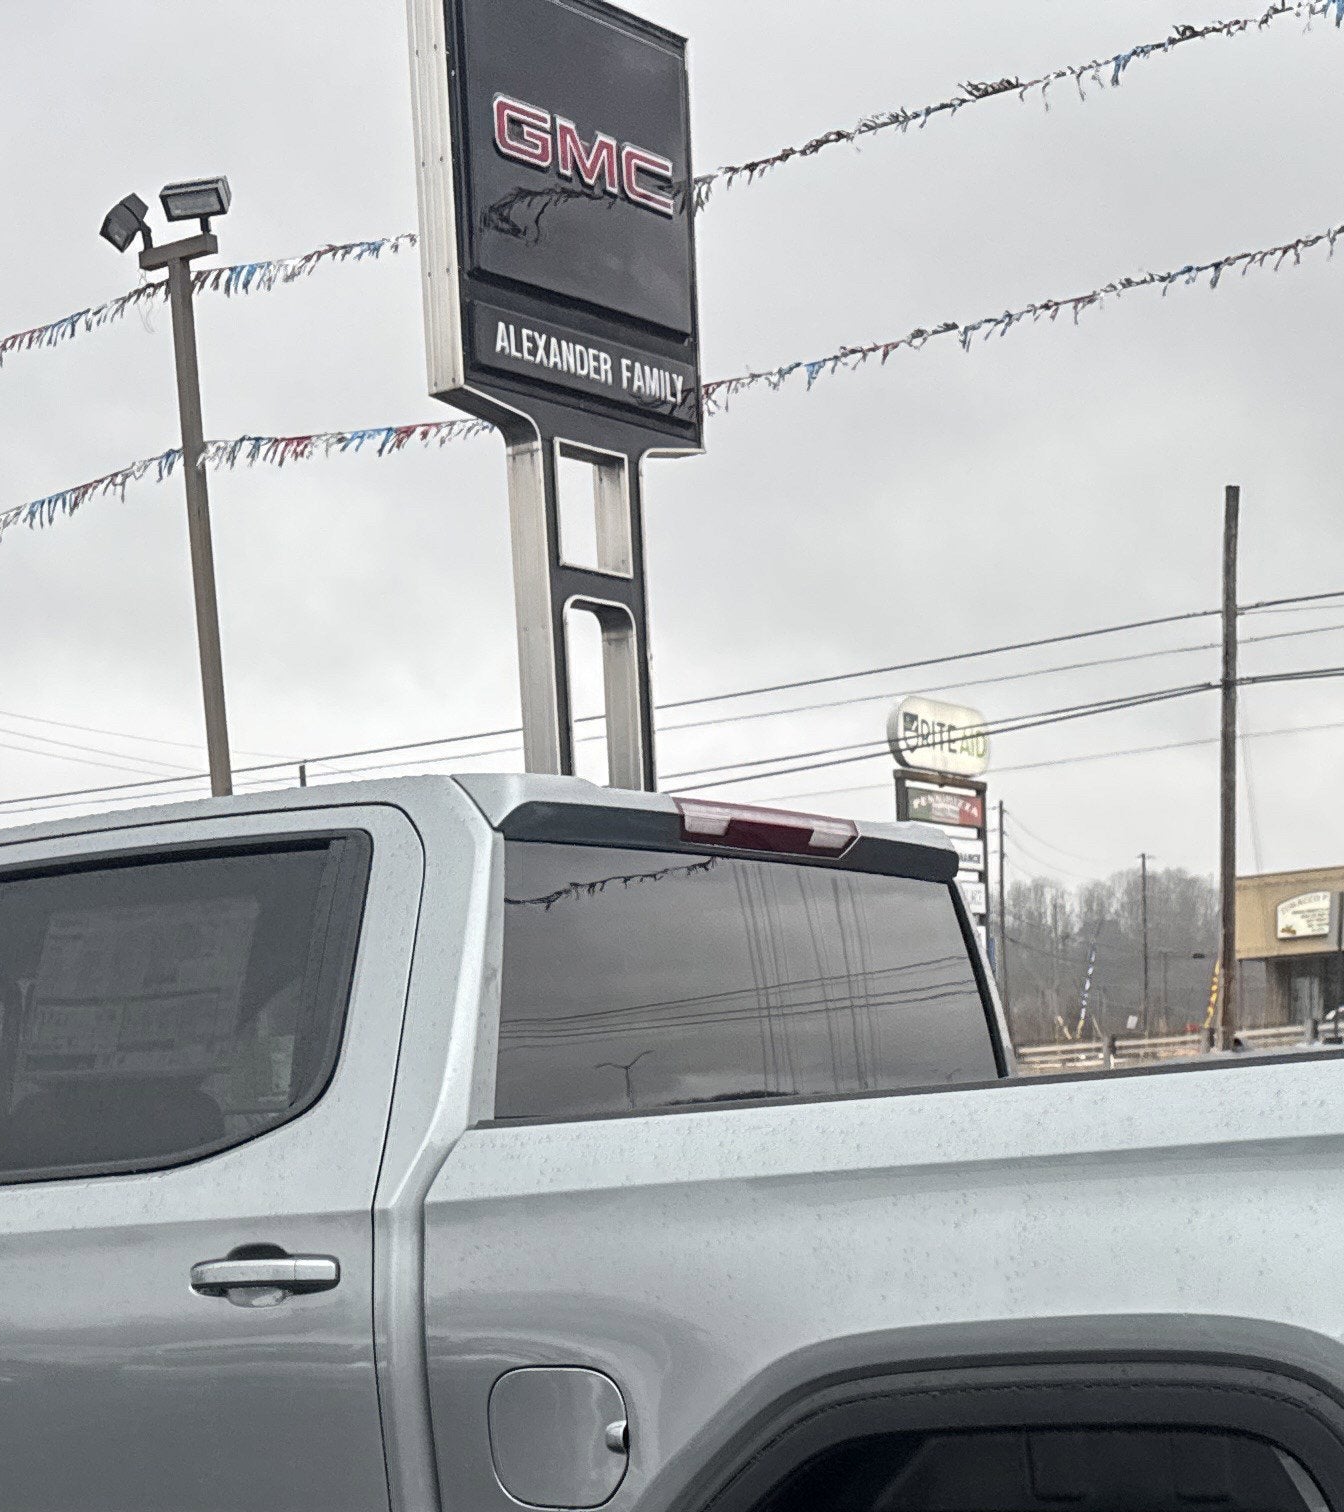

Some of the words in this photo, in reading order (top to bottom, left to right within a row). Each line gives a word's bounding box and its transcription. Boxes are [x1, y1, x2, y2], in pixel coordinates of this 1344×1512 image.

[493, 93, 674, 217] GMC
[495, 321, 613, 386] ALEXANDER
[621, 358, 684, 404] FAMILY
